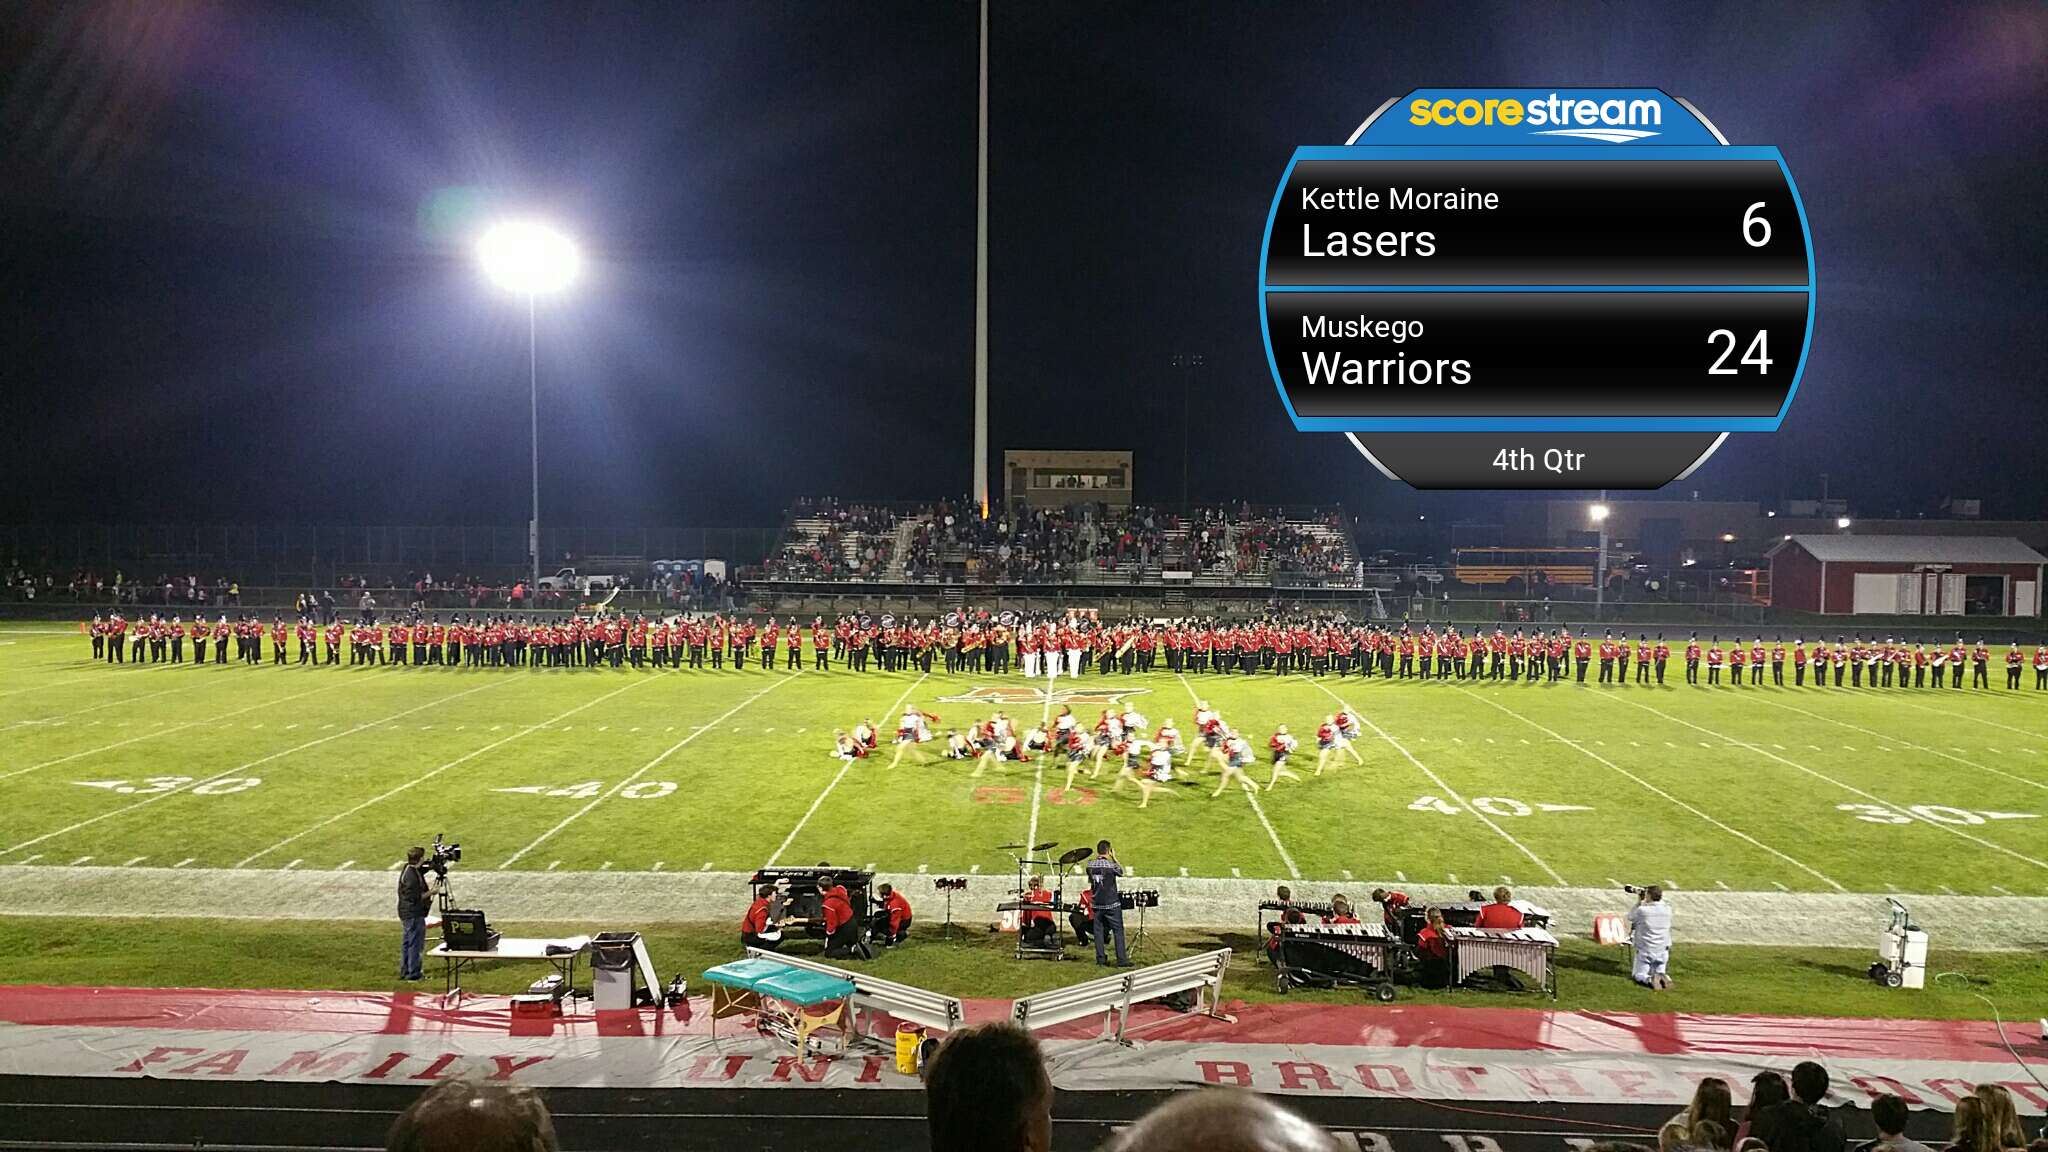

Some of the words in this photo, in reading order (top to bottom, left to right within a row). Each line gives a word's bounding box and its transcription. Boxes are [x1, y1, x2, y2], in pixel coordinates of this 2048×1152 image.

[116, 777, 262, 795] 30
[544, 781, 678, 798] 40
[1407, 796, 1533, 816] 40
[1835, 803, 1986, 825] 30
[1601, 917, 1625, 943] 40
[114, 1046, 554, 1081] FAMILY
[681, 1055, 890, 1083] UNI
